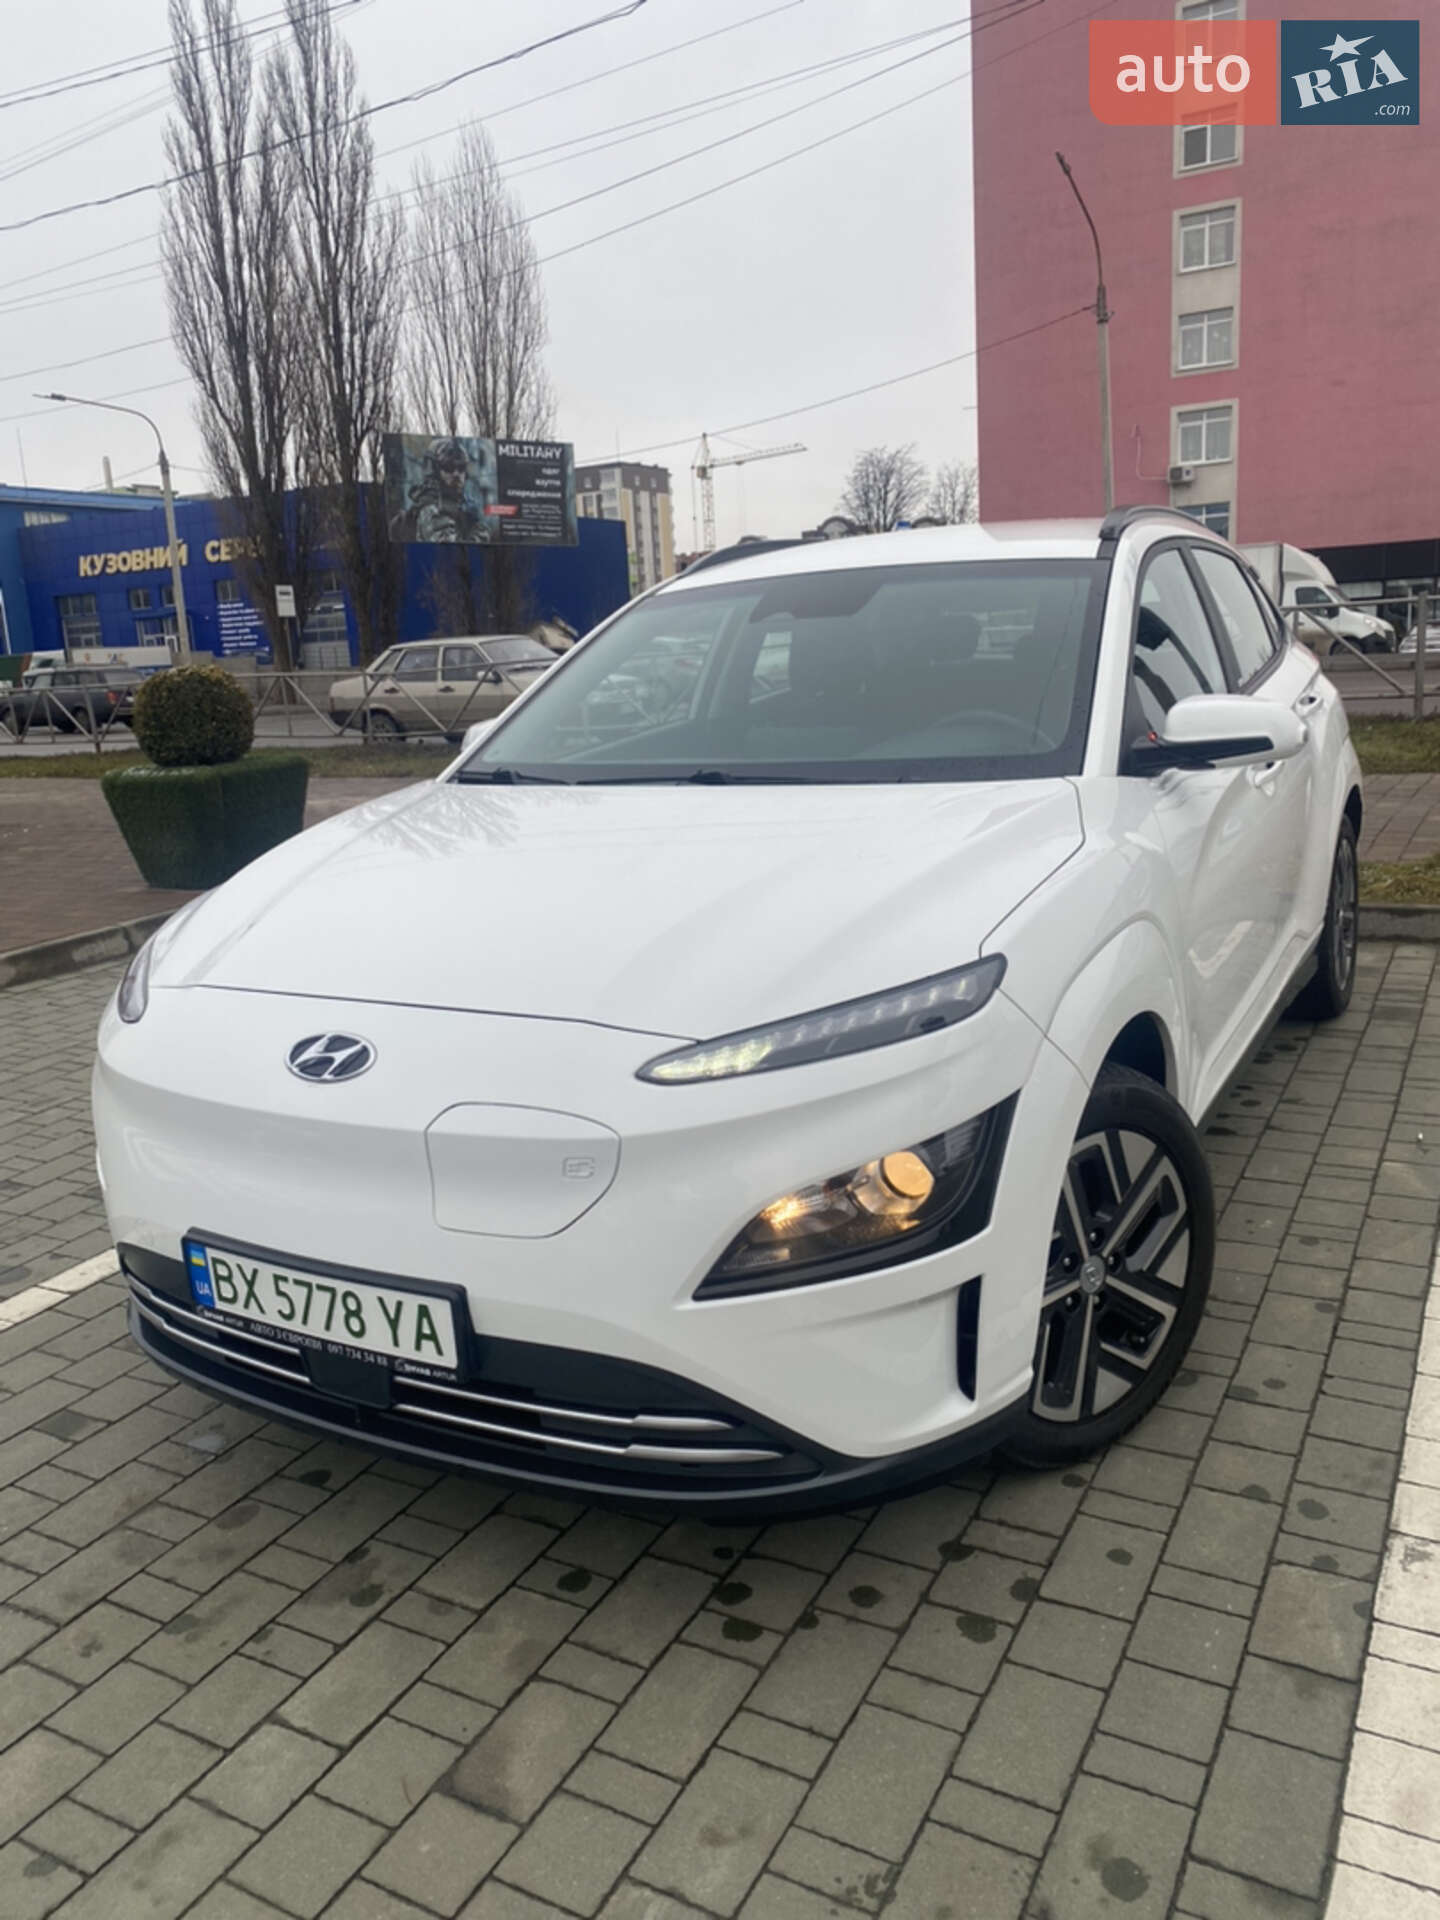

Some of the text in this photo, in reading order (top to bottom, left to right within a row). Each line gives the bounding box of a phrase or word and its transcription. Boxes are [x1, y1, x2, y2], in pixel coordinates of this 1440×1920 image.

[498, 443, 562, 460] MILITARY
[79, 538, 188, 578] КУЗОВНИЙ
[195, 1279, 212, 1297] UA
[211, 1256, 444, 1357] BX 5778 YA
